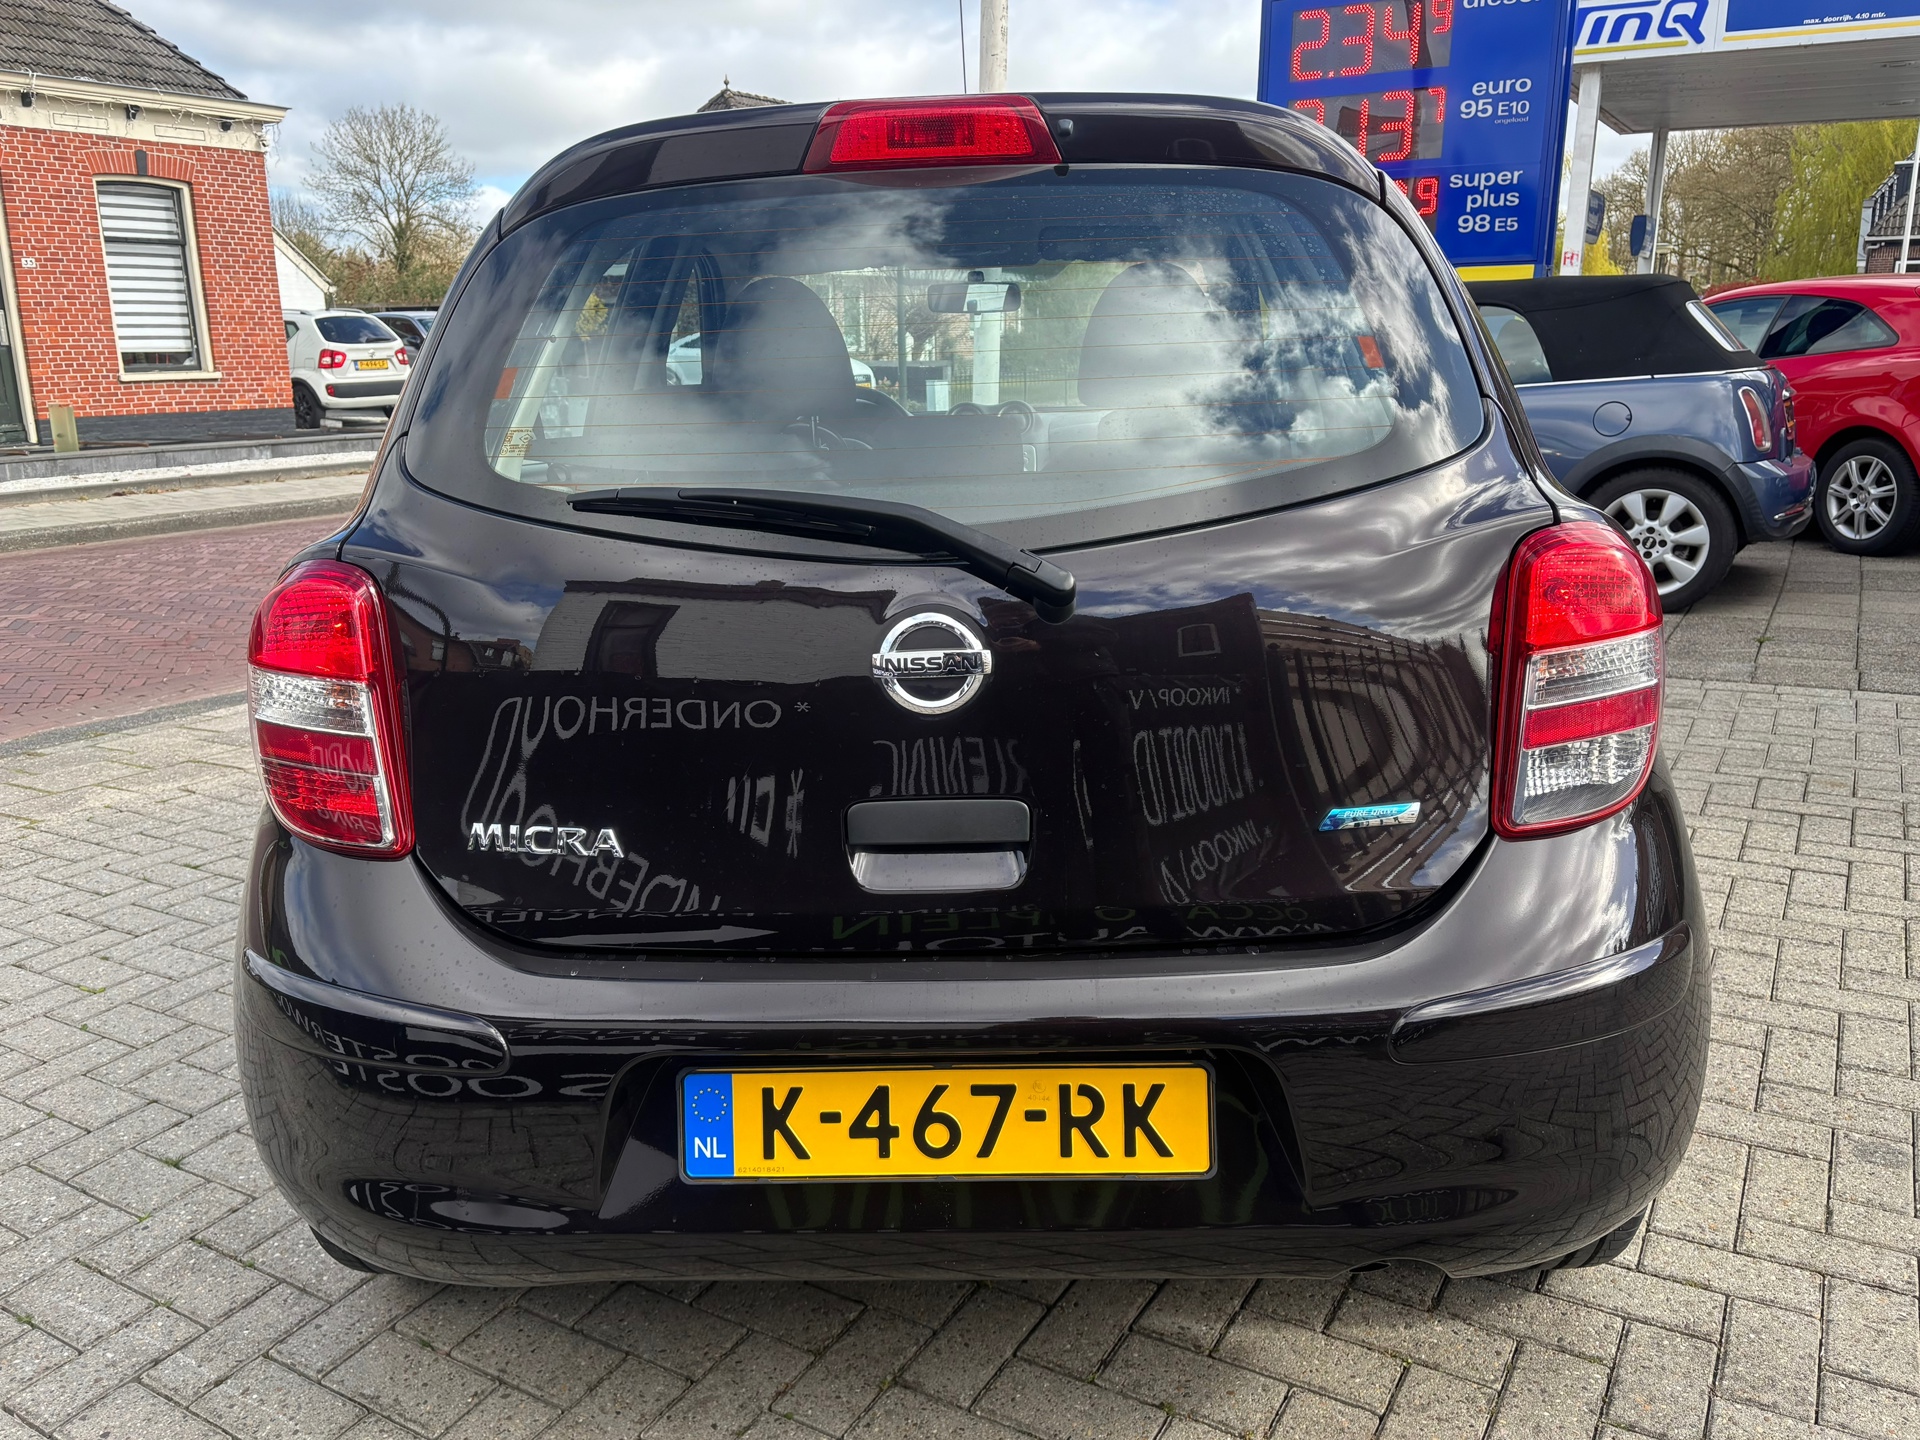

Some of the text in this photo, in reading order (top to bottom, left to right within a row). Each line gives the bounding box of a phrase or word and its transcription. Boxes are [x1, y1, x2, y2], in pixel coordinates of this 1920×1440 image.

[1855, 12, 1870, 20] 4.10
[1471, 77, 1532, 96] euro
[1460, 98, 1530, 119] 95 E10
[1494, 116, 1529, 125] ongelood
[1449, 168, 1523, 191] super
[1466, 188, 1520, 212] plus
[1457, 213, 1519, 234] 98 E5
[884, 653, 983, 674] NISSAN
[1344, 807, 1398, 818] PURE DRIVE
[467, 822, 625, 858] MICRA
[761, 1083, 1175, 1160] K-467-RK
[694, 1136, 727, 1159] NL
